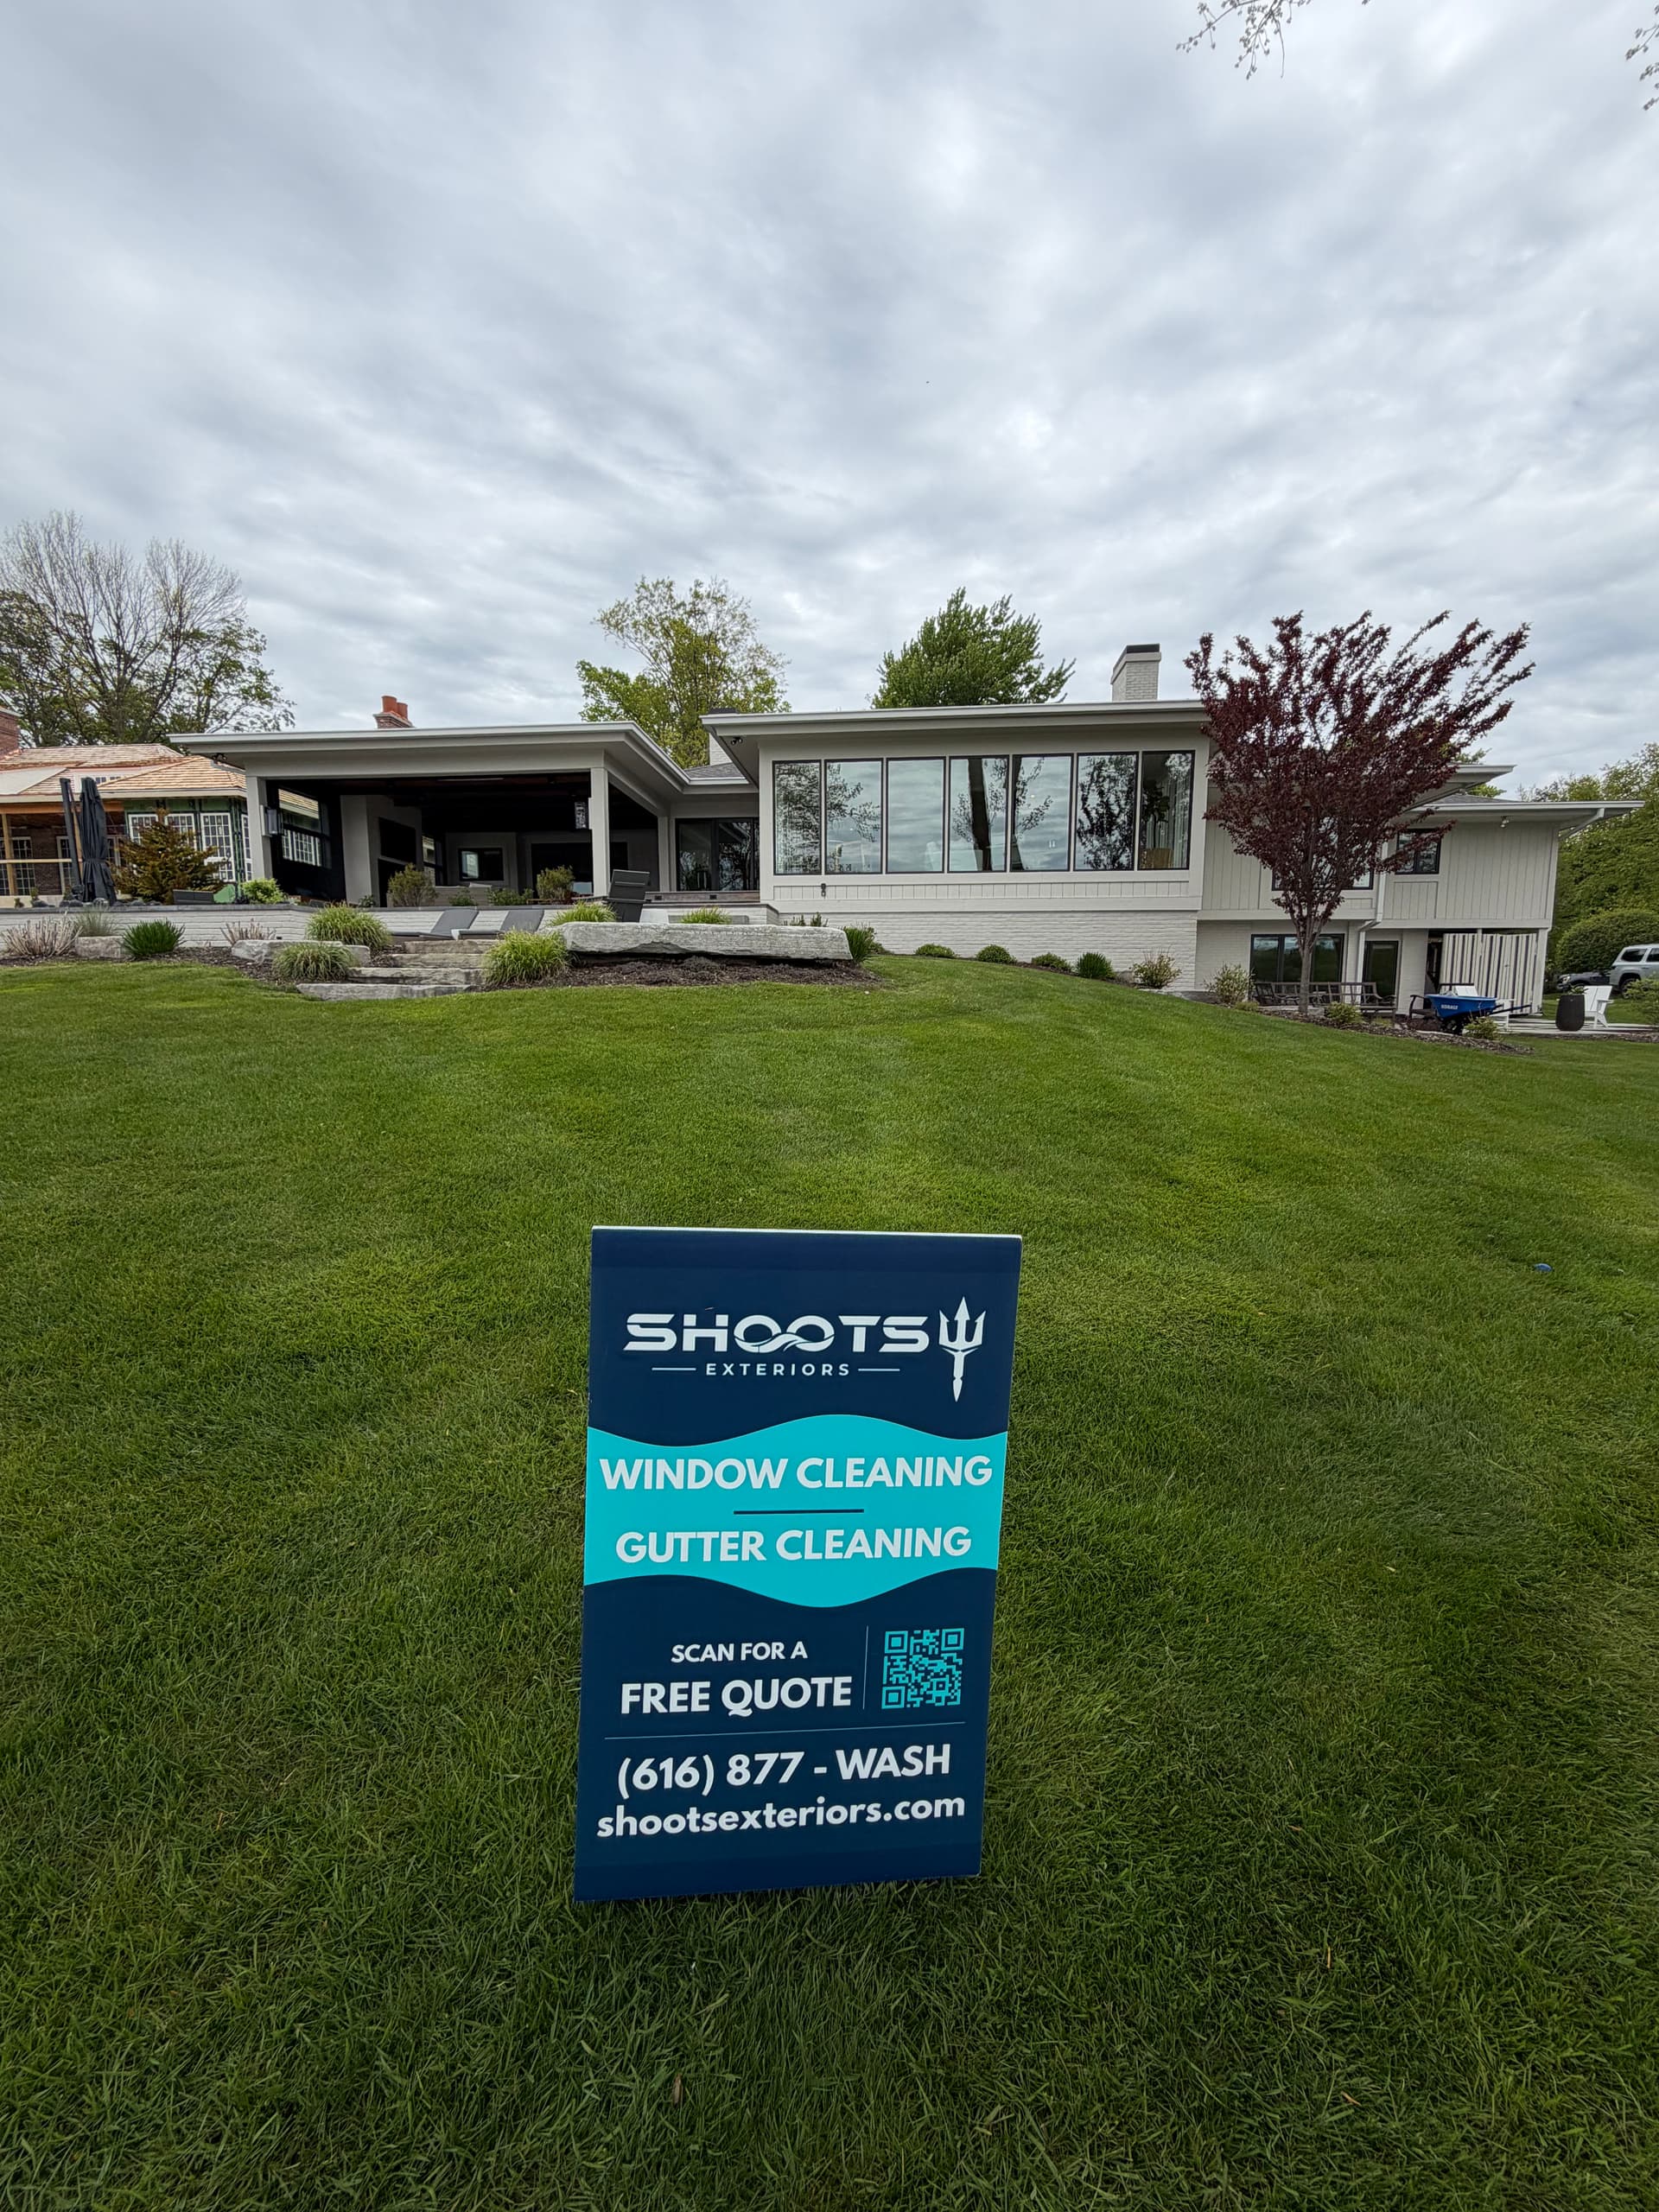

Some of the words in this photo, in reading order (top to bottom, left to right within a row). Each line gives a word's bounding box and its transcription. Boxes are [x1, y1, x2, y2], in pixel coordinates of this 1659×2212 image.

[624, 1313, 930, 1353] SHOOTS
[706, 1363, 849, 1376] EXTERIORS
[599, 1458, 790, 1490] WINDOW
[796, 1455, 993, 1489] CLEANING
[615, 1531, 766, 1563] GUTTER
[775, 1526, 971, 1560] CLEANING
[671, 1643, 734, 1663] SCAN
[741, 1642, 785, 1661] FOR
[790, 1641, 808, 1659] A
[621, 1681, 710, 1714] FREE
[721, 1676, 852, 1717] QUOTE
[618, 1754, 715, 1800] (616)
[726, 1751, 804, 1786] 877
[836, 1744, 950, 1780] WASH
[597, 1796, 965, 1837] shootsexteriors.com
